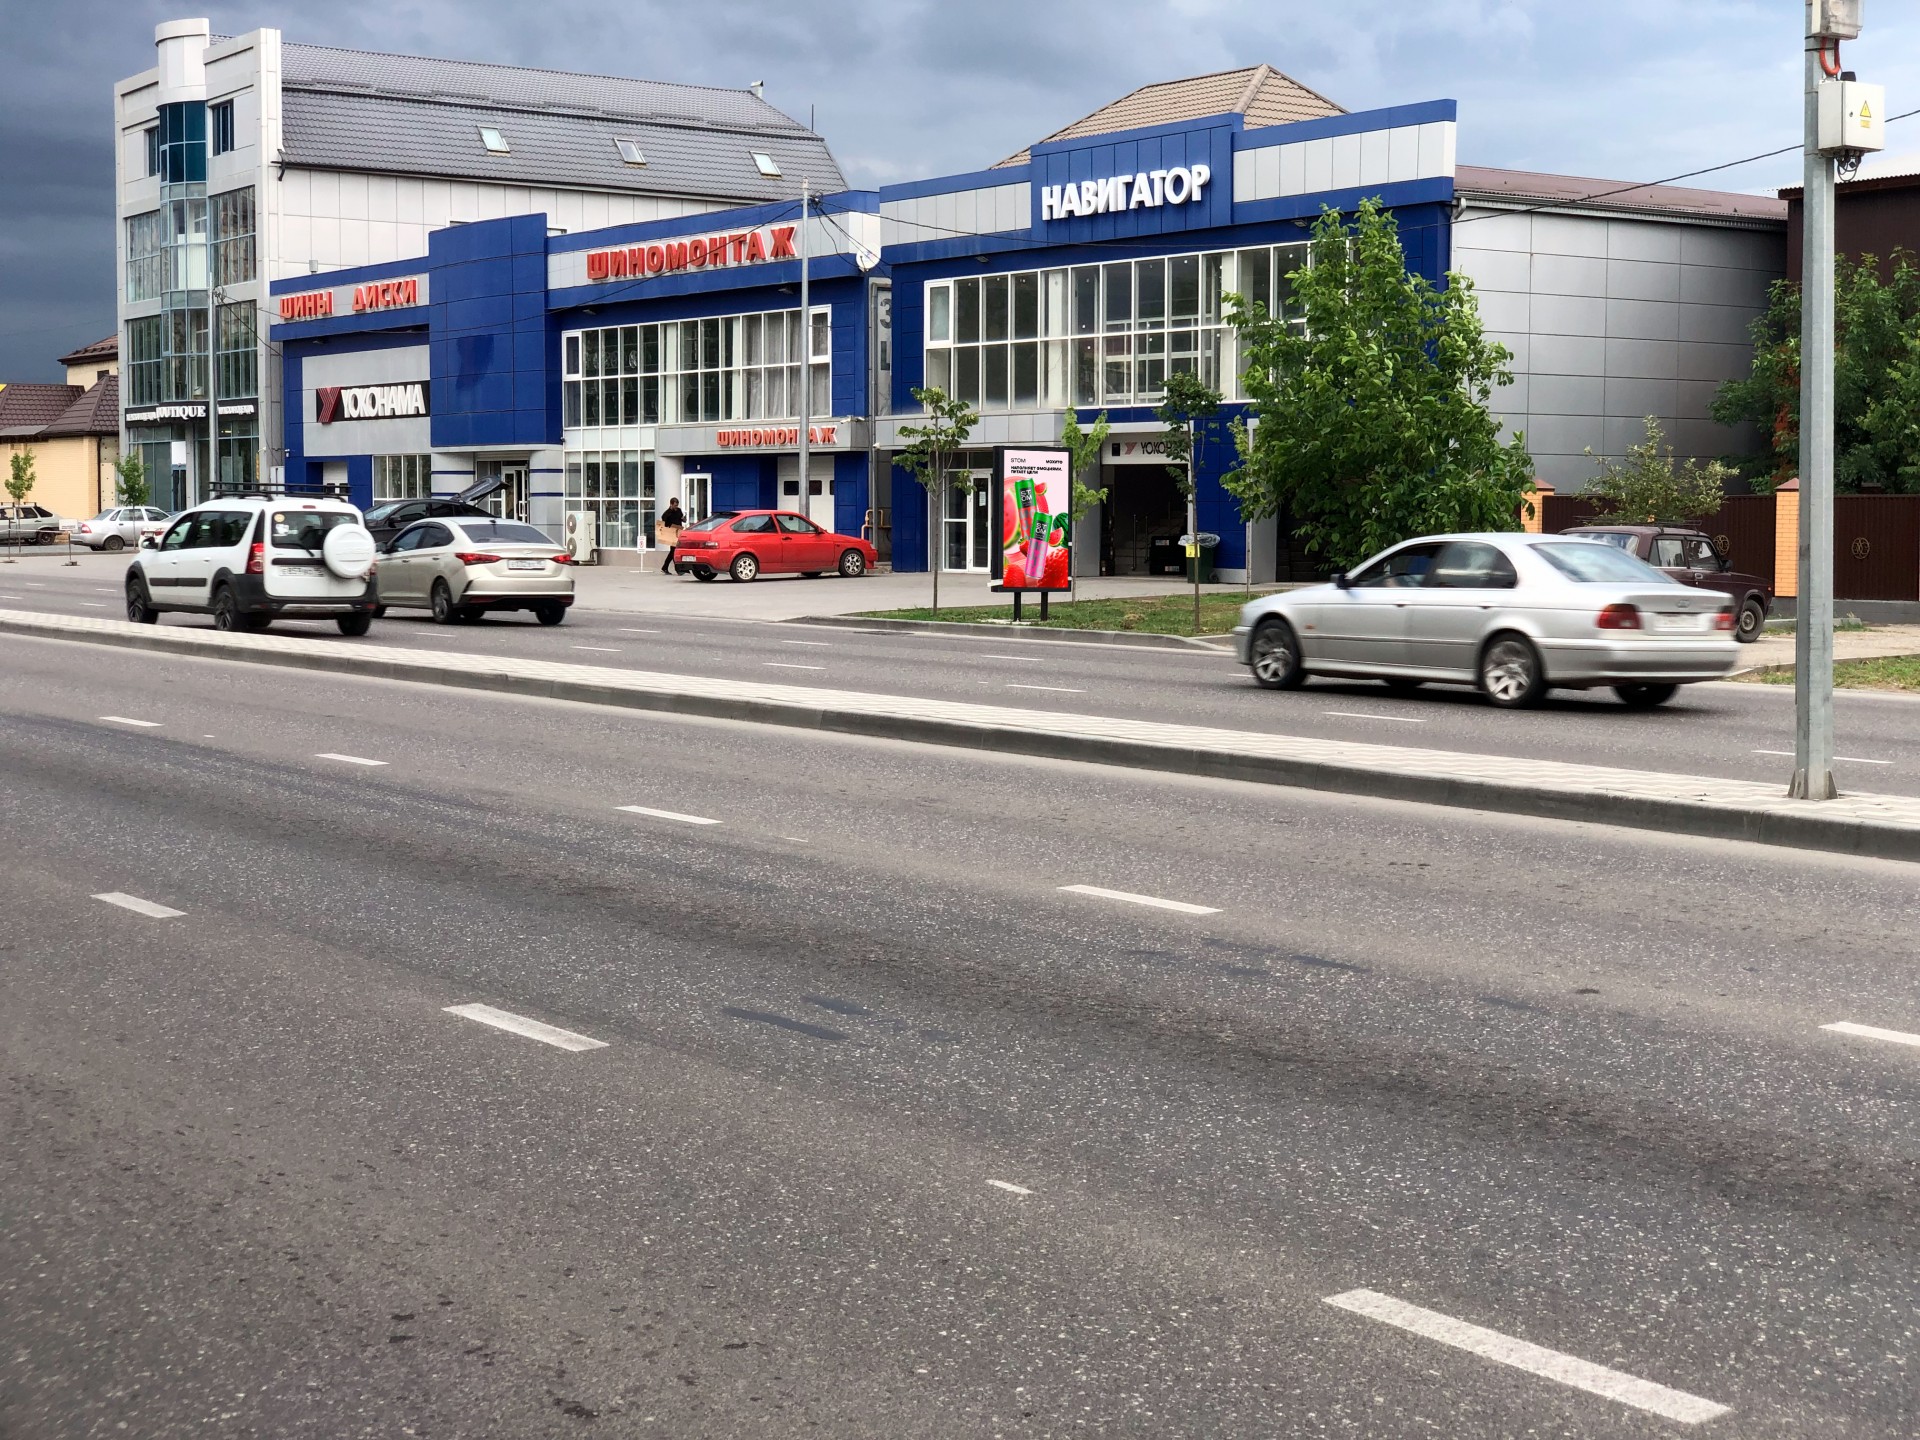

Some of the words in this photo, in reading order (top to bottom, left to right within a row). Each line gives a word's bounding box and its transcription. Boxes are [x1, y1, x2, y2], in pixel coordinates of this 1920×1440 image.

[1042, 164, 1211, 221] НАВИГАТОР
[587, 225, 797, 280] ШИНОМОНТАЖ
[280, 290, 333, 319] ШИНЫ
[352, 278, 418, 311] ДИСКИ
[341, 384, 426, 418] YOKOHAMA
[717, 425, 837, 446] ШИНОМОНАЖ
